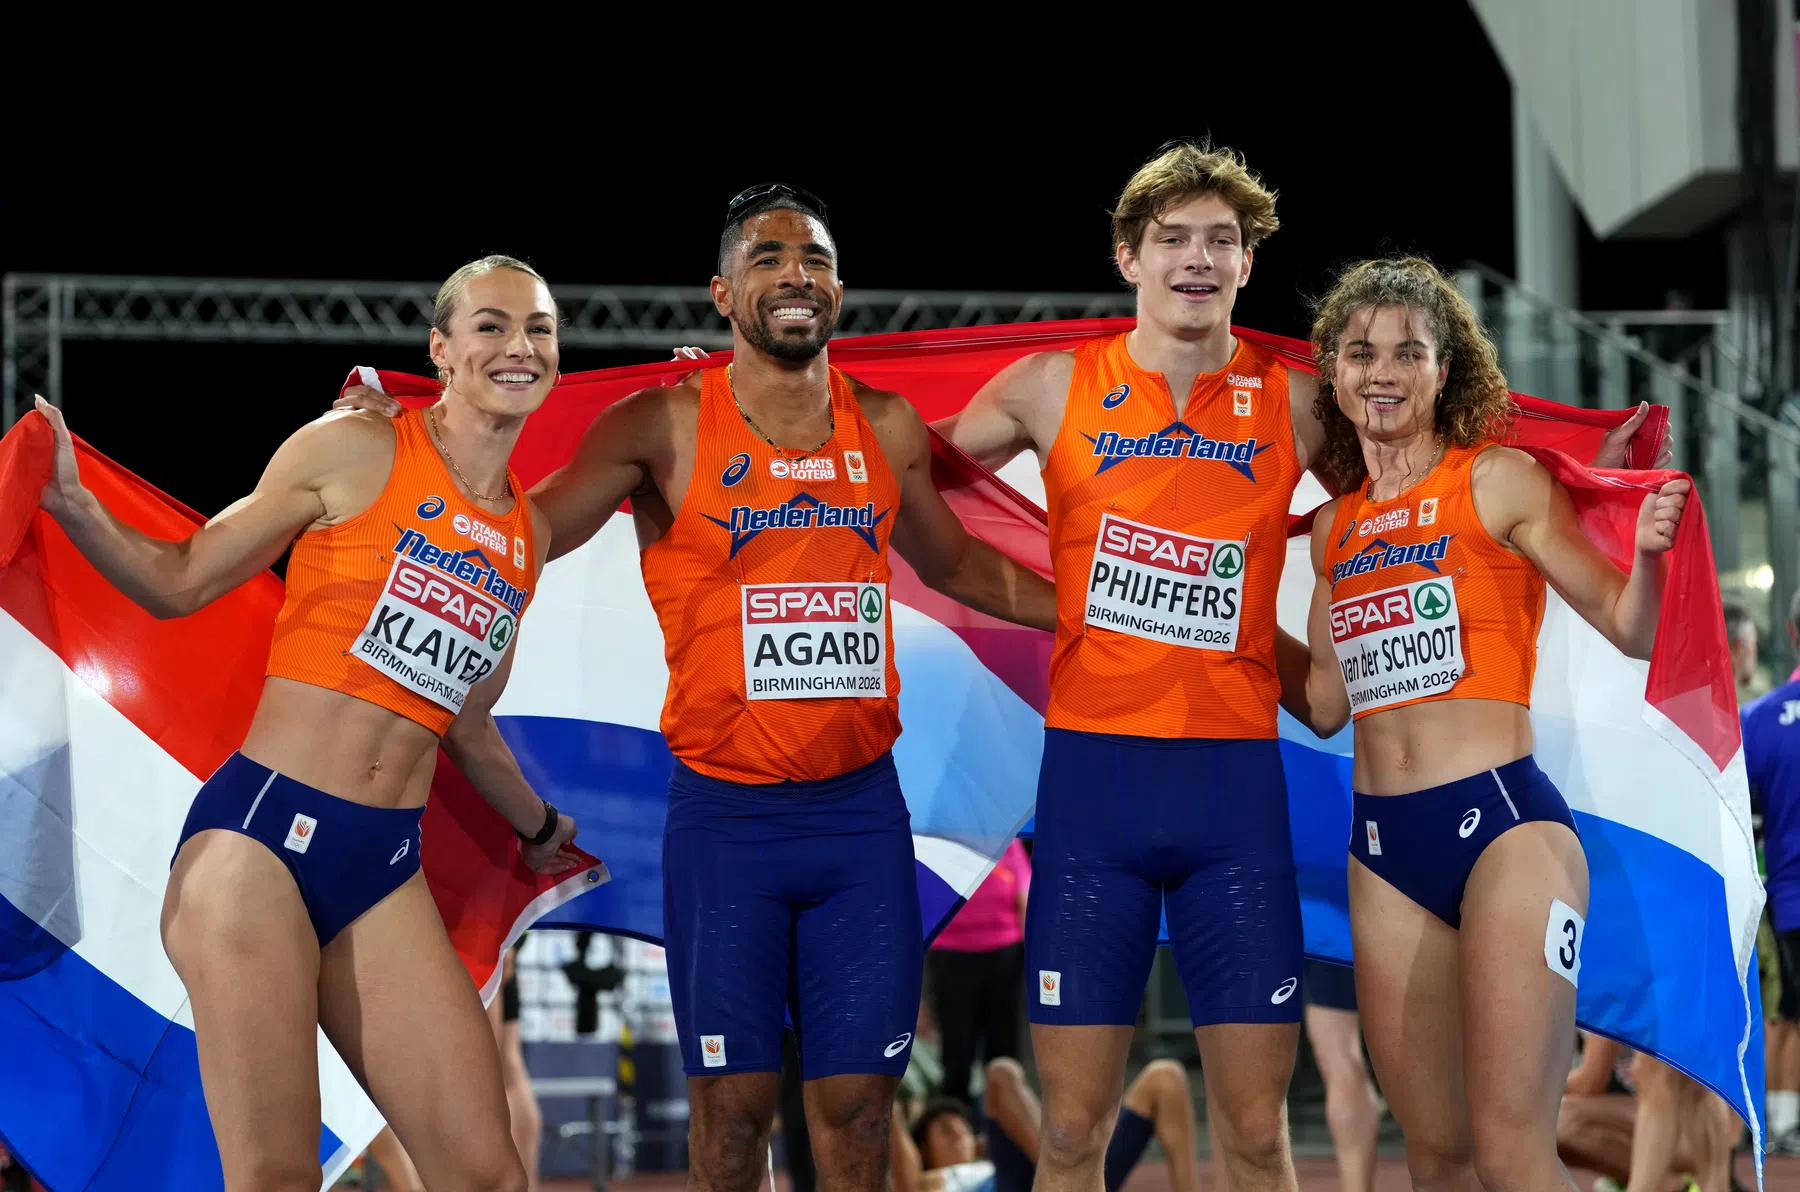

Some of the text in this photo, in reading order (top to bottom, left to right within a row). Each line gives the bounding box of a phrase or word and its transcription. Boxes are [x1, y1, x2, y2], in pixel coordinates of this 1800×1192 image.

[1235, 374, 1262, 384] STAATS
[790, 458, 834, 469] STAATS
[791, 468, 835, 480] LOTERIJ
[472, 520, 507, 546] STAATS
[1371, 517, 1409, 534] LOTERIJ
[1374, 508, 1410, 525] STAATS
[470, 529, 507, 556] LOTERIJ
[1104, 526, 1209, 572] SPAR
[394, 567, 492, 635] SPAR
[750, 591, 856, 618] SPAR
[1090, 561, 1237, 620] PHIJFFERS
[1087, 604, 1231, 644] BIRMINGHAM 2026
[1331, 595, 1410, 637] SPAR
[371, 605, 492, 685] KLAVER
[753, 631, 880, 668] AGARD
[1340, 624, 1456, 684] van der SCHOOT
[361, 638, 454, 700] BIRMINGHAM
[753, 676, 881, 692] BIRMINGHAM 2026
[1351, 668, 1459, 707] BIRMINGHAM 2026
[1559, 919, 1577, 970] 3
